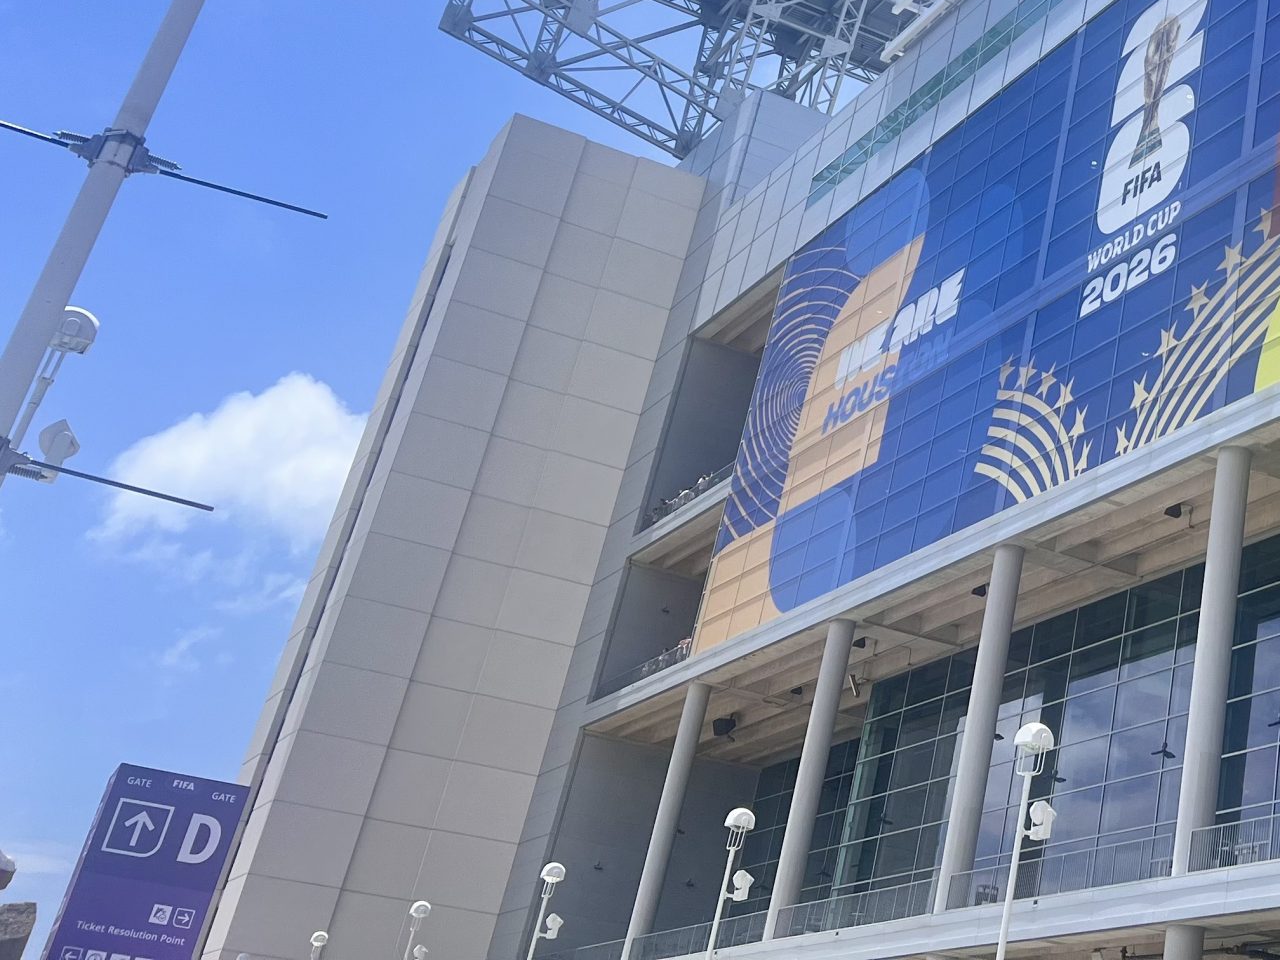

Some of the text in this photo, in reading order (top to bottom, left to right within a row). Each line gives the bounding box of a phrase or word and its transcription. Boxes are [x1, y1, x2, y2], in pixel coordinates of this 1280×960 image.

[1121, 161, 1162, 206] FIFA
[1087, 200, 1182, 274] WORLD CUP
[1079, 233, 1177, 318] 2026
[835, 267, 966, 390] WE ARE
[127, 776, 152, 787] GATE
[172, 779, 194, 790] FIFA
[212, 791, 236, 802] GATE
[176, 813, 221, 863] D
[77, 920, 185, 946] Ticket Resolution Point
